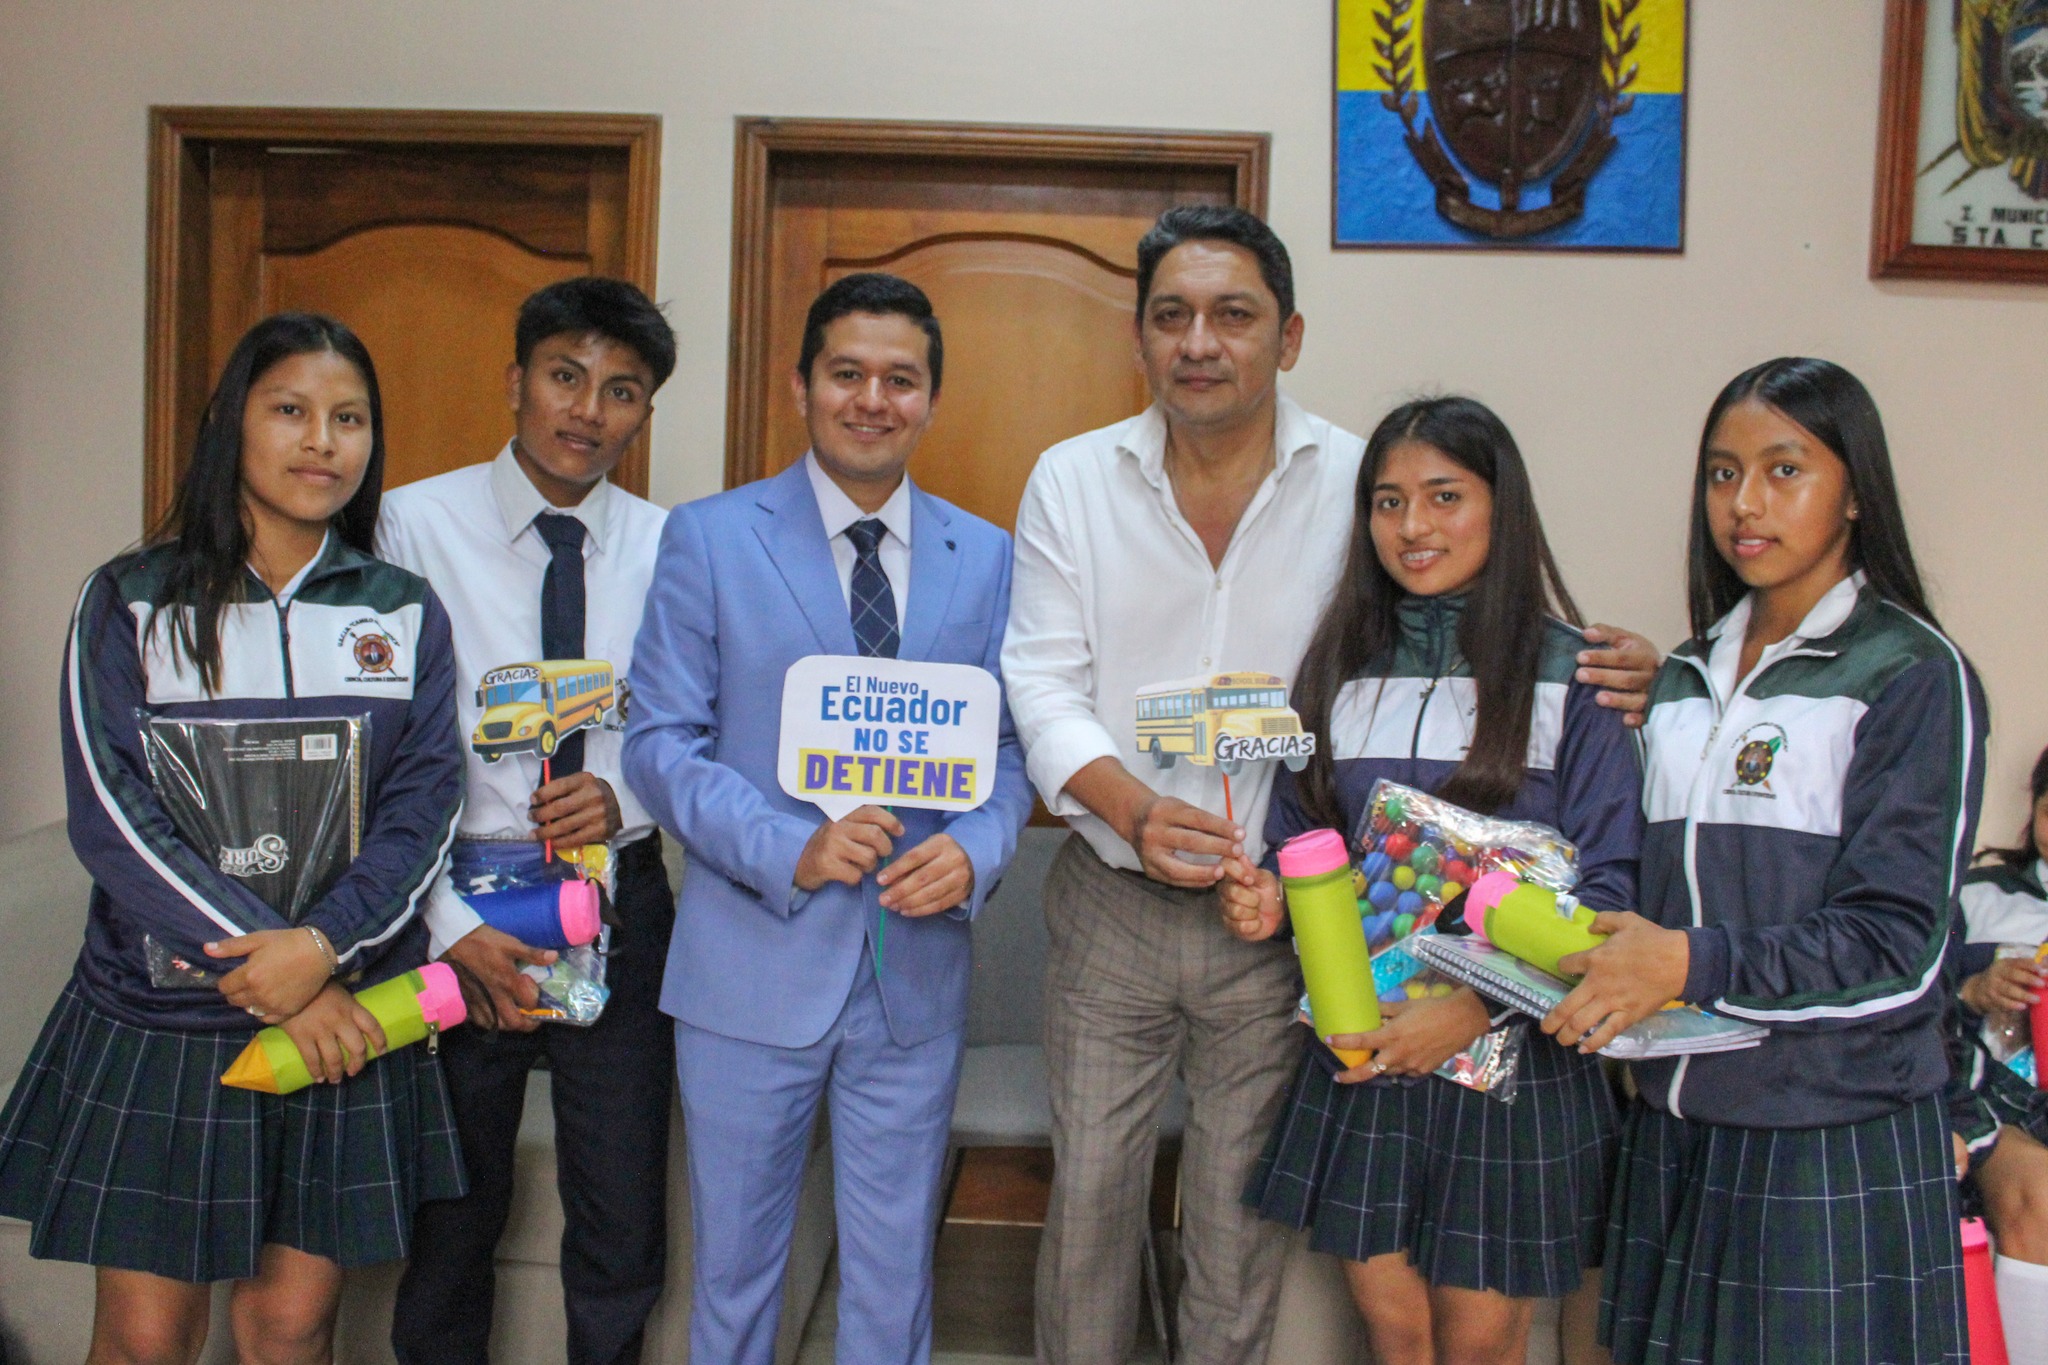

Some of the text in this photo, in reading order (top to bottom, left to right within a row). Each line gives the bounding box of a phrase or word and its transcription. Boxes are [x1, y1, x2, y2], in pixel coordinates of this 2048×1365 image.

[1952, 225, 2006, 245] STA
[846, 675, 918, 695] El Nuevo
[820, 685, 968, 726] Ecuador
[853, 728, 929, 755] NO SE
[1214, 734, 1313, 760] GRACIAS
[805, 753, 974, 800] DETIENE
[222, 833, 285, 874] SURF
